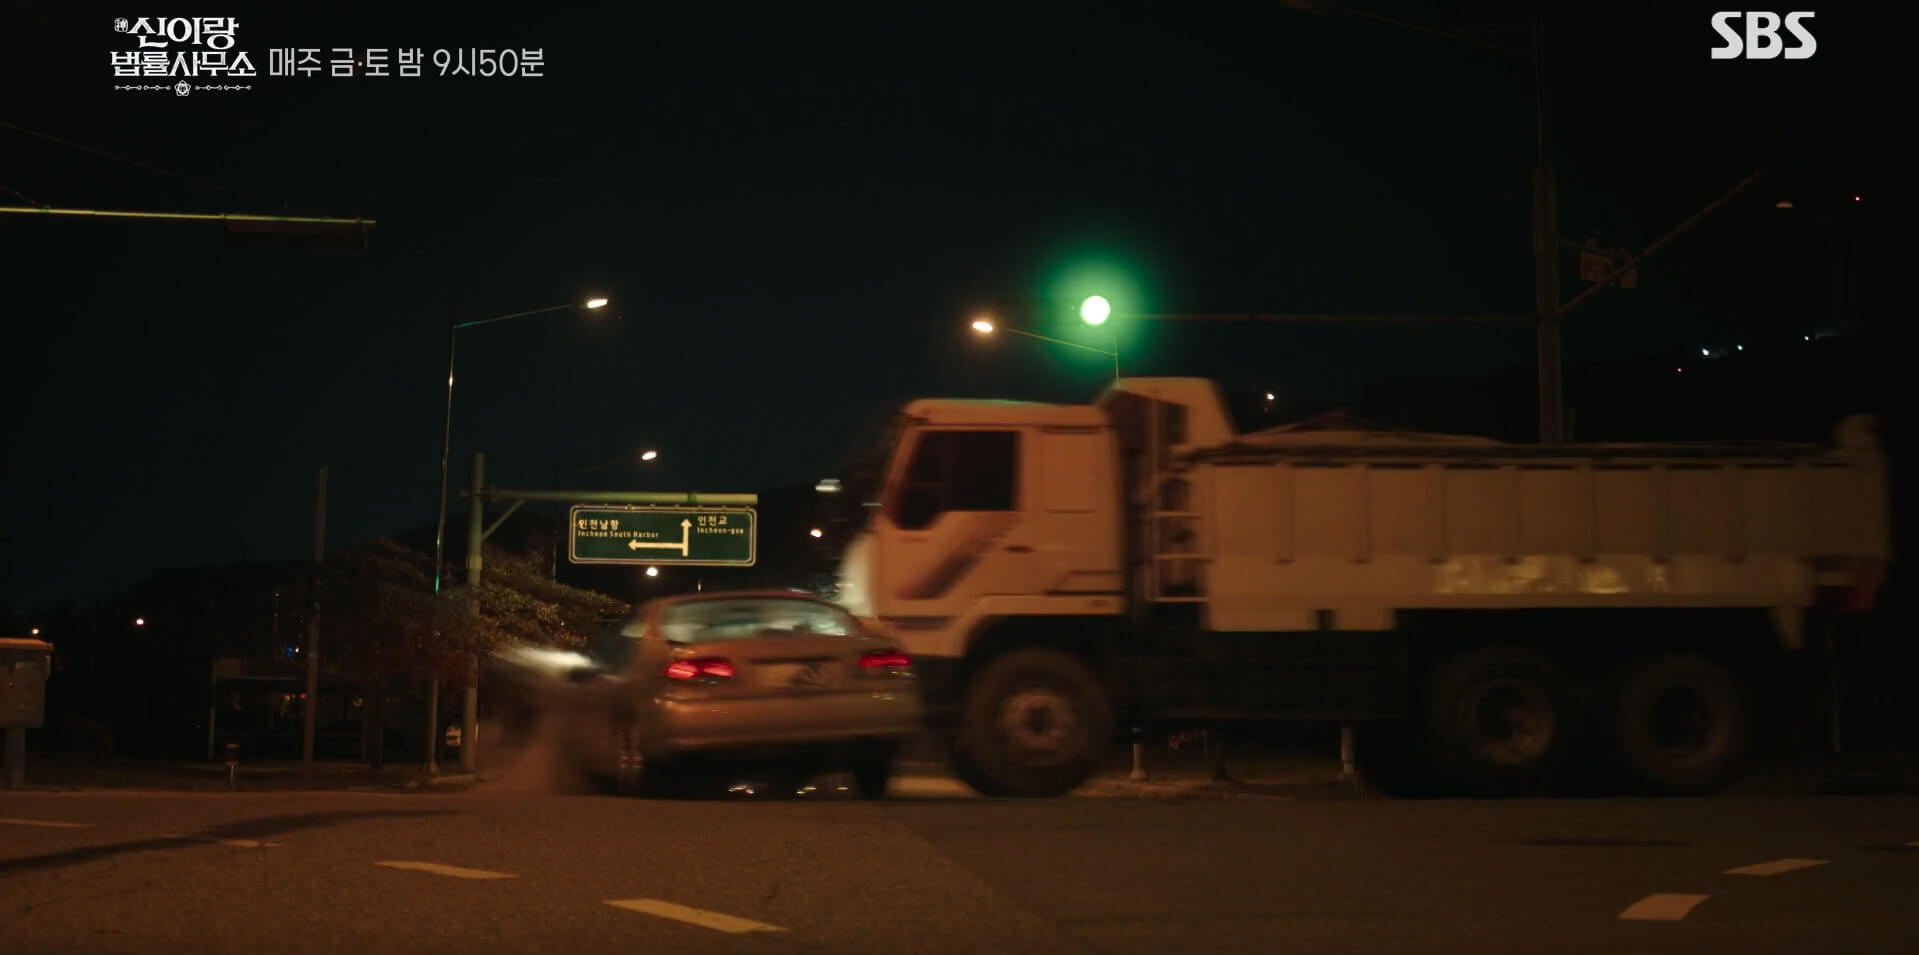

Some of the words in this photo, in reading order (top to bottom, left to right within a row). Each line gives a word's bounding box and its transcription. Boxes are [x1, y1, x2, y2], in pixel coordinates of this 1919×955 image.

[578, 519, 619, 530] 인천남항
[697, 515, 728, 526] 인천교
[609, 530, 631, 538] South
